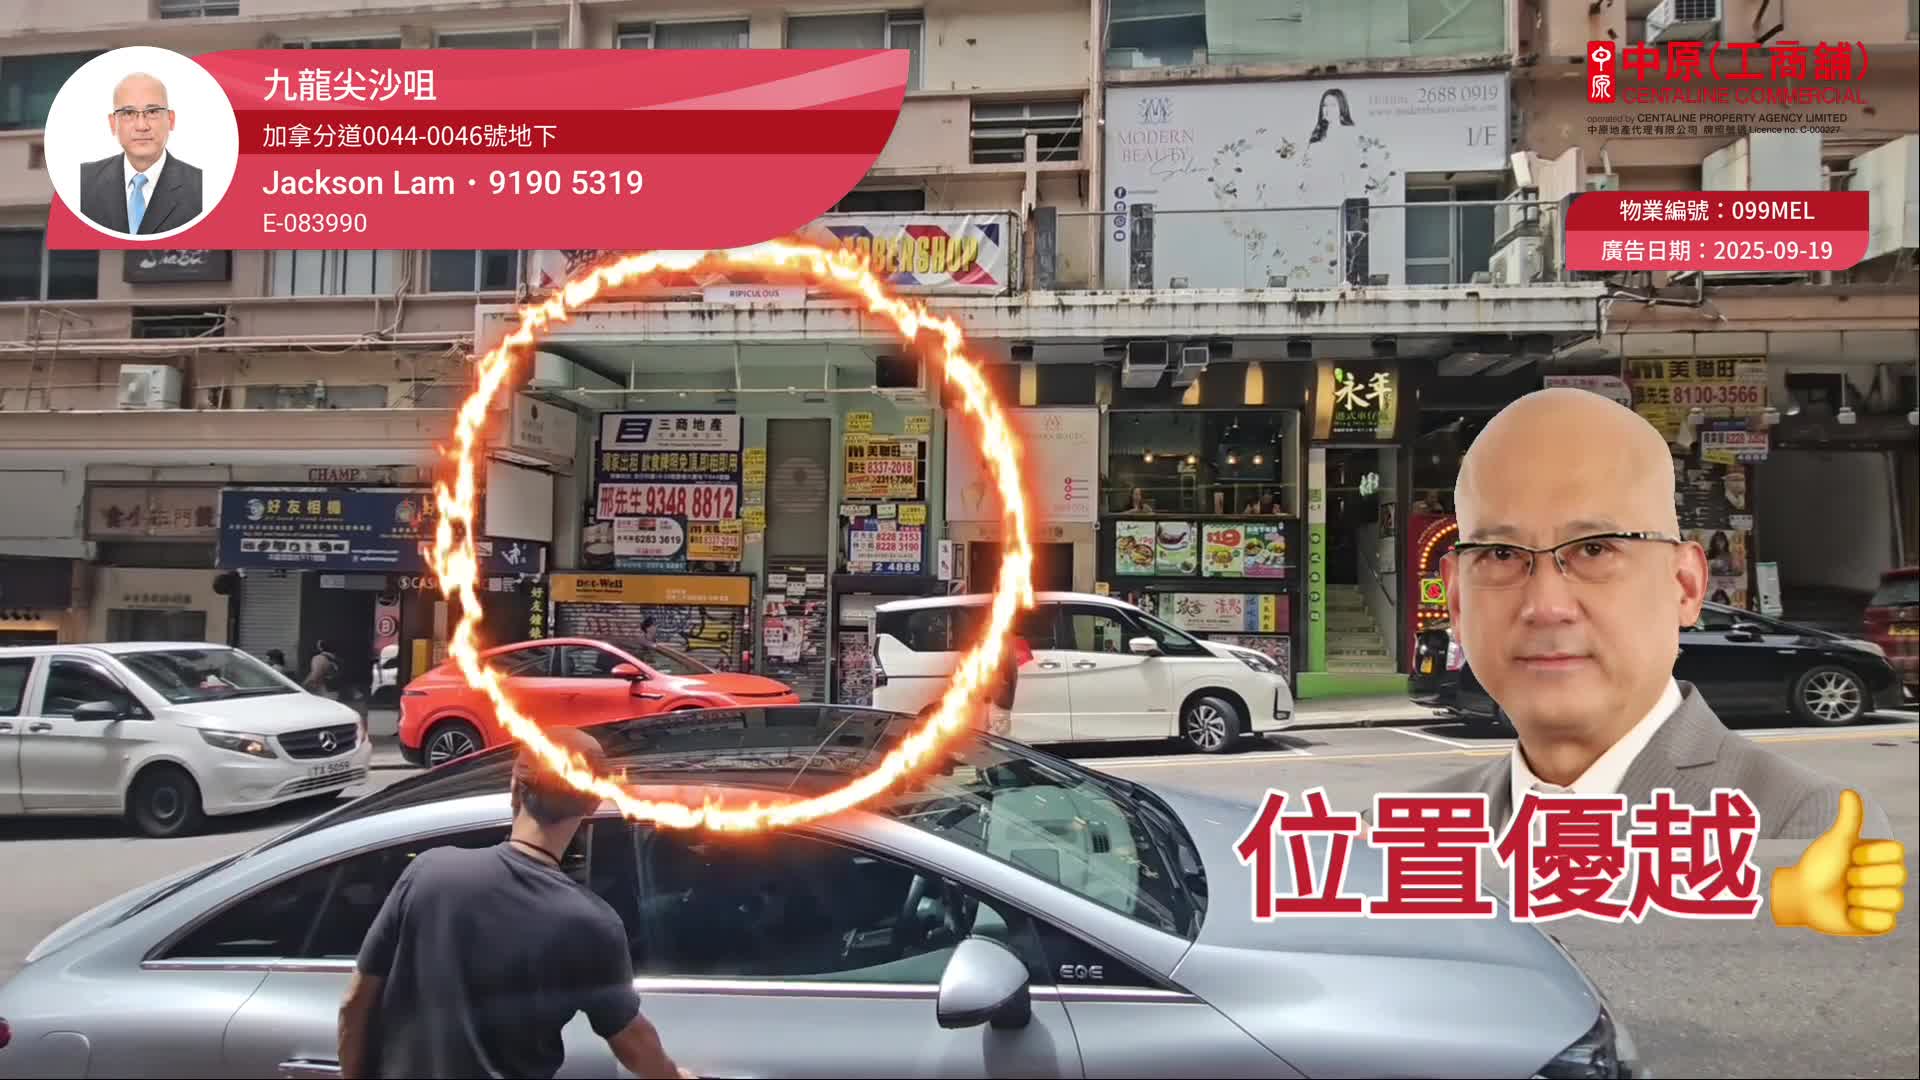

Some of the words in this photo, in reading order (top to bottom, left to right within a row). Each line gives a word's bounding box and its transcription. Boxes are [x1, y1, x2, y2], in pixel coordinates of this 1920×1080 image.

[1416, 87, 1457, 103] 2688
[1461, 84, 1498, 101] 0919
[1119, 129, 1194, 145] MODERN
[1334, 372, 1392, 410] 永年
[657, 418, 722, 431] 三商地產
[646, 487, 686, 515] 9348
[692, 487, 734, 518] 8812
[1060, 964, 1104, 978] EQE
